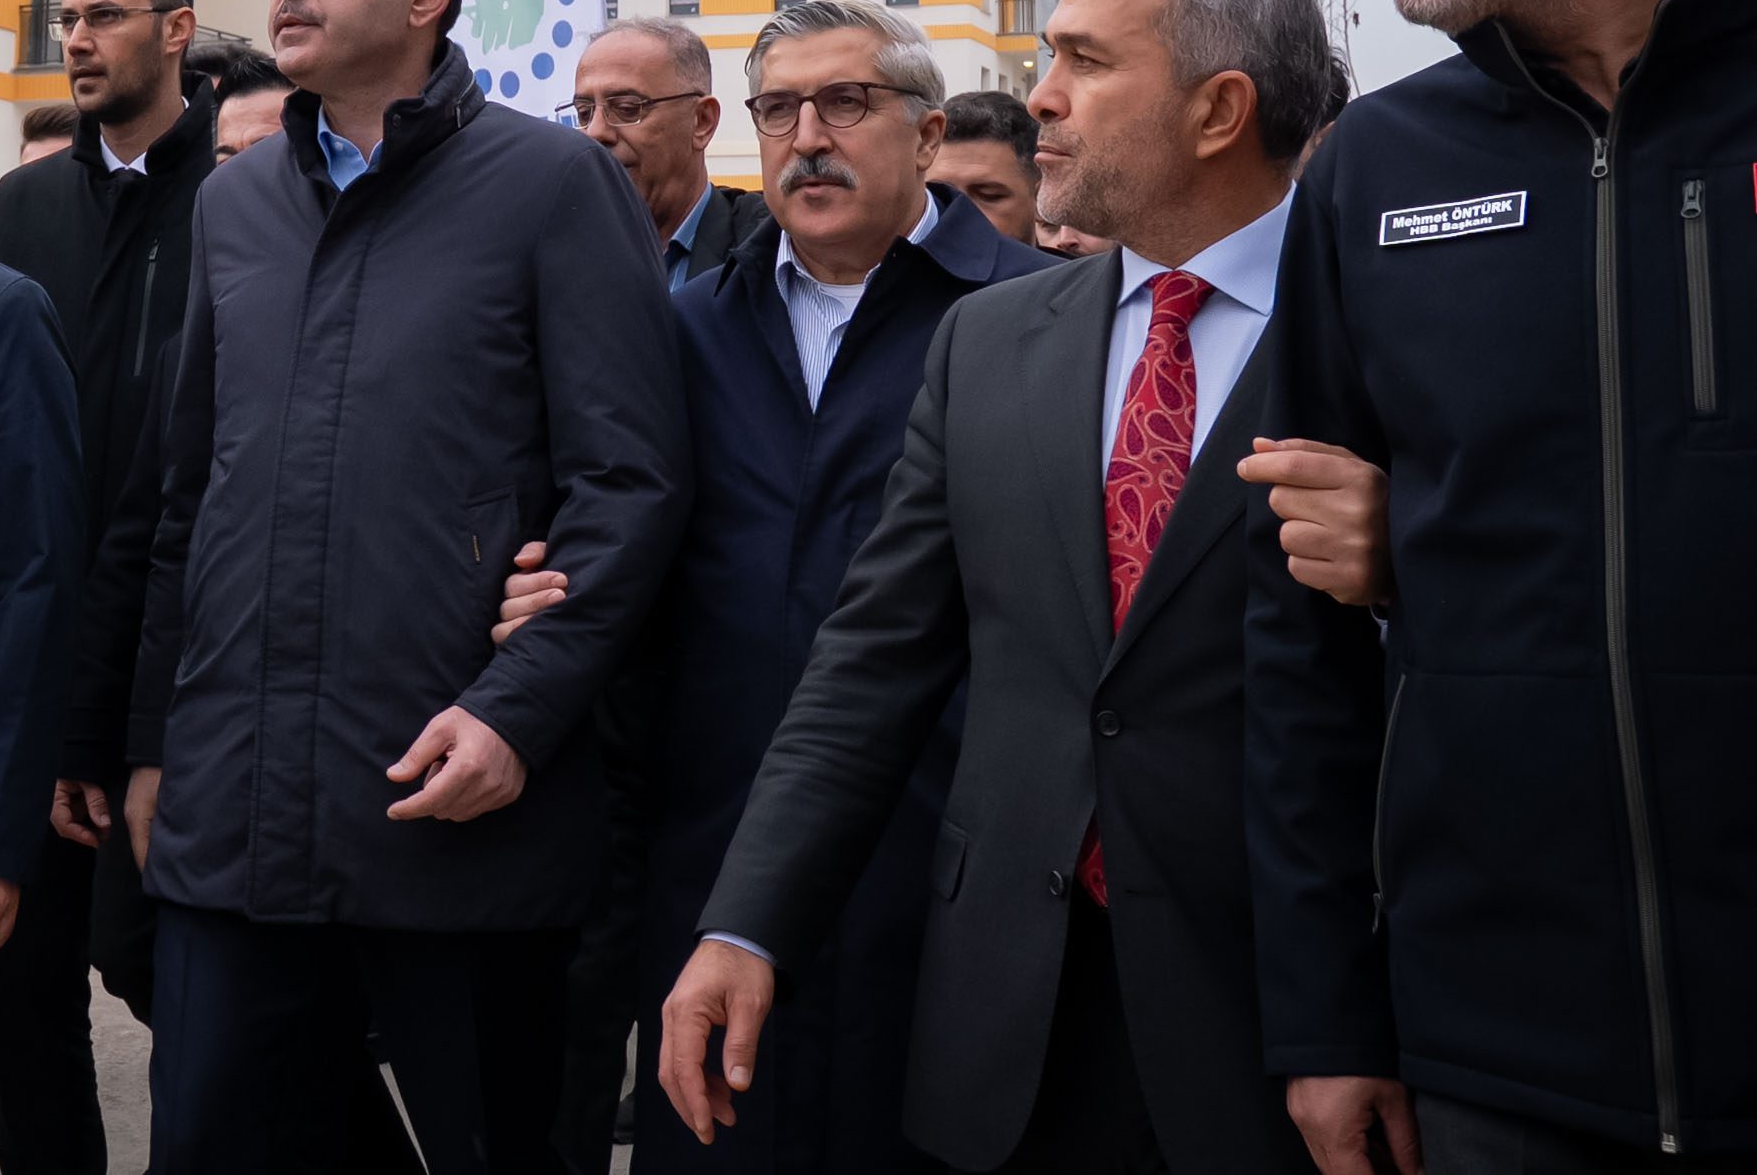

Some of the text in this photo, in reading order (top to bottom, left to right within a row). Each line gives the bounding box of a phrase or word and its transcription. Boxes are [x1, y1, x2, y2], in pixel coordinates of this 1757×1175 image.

[1392, 199, 1513, 229] Mehmet ÖNTÜRK
[1410, 216, 1493, 236] HBB Başkanı
